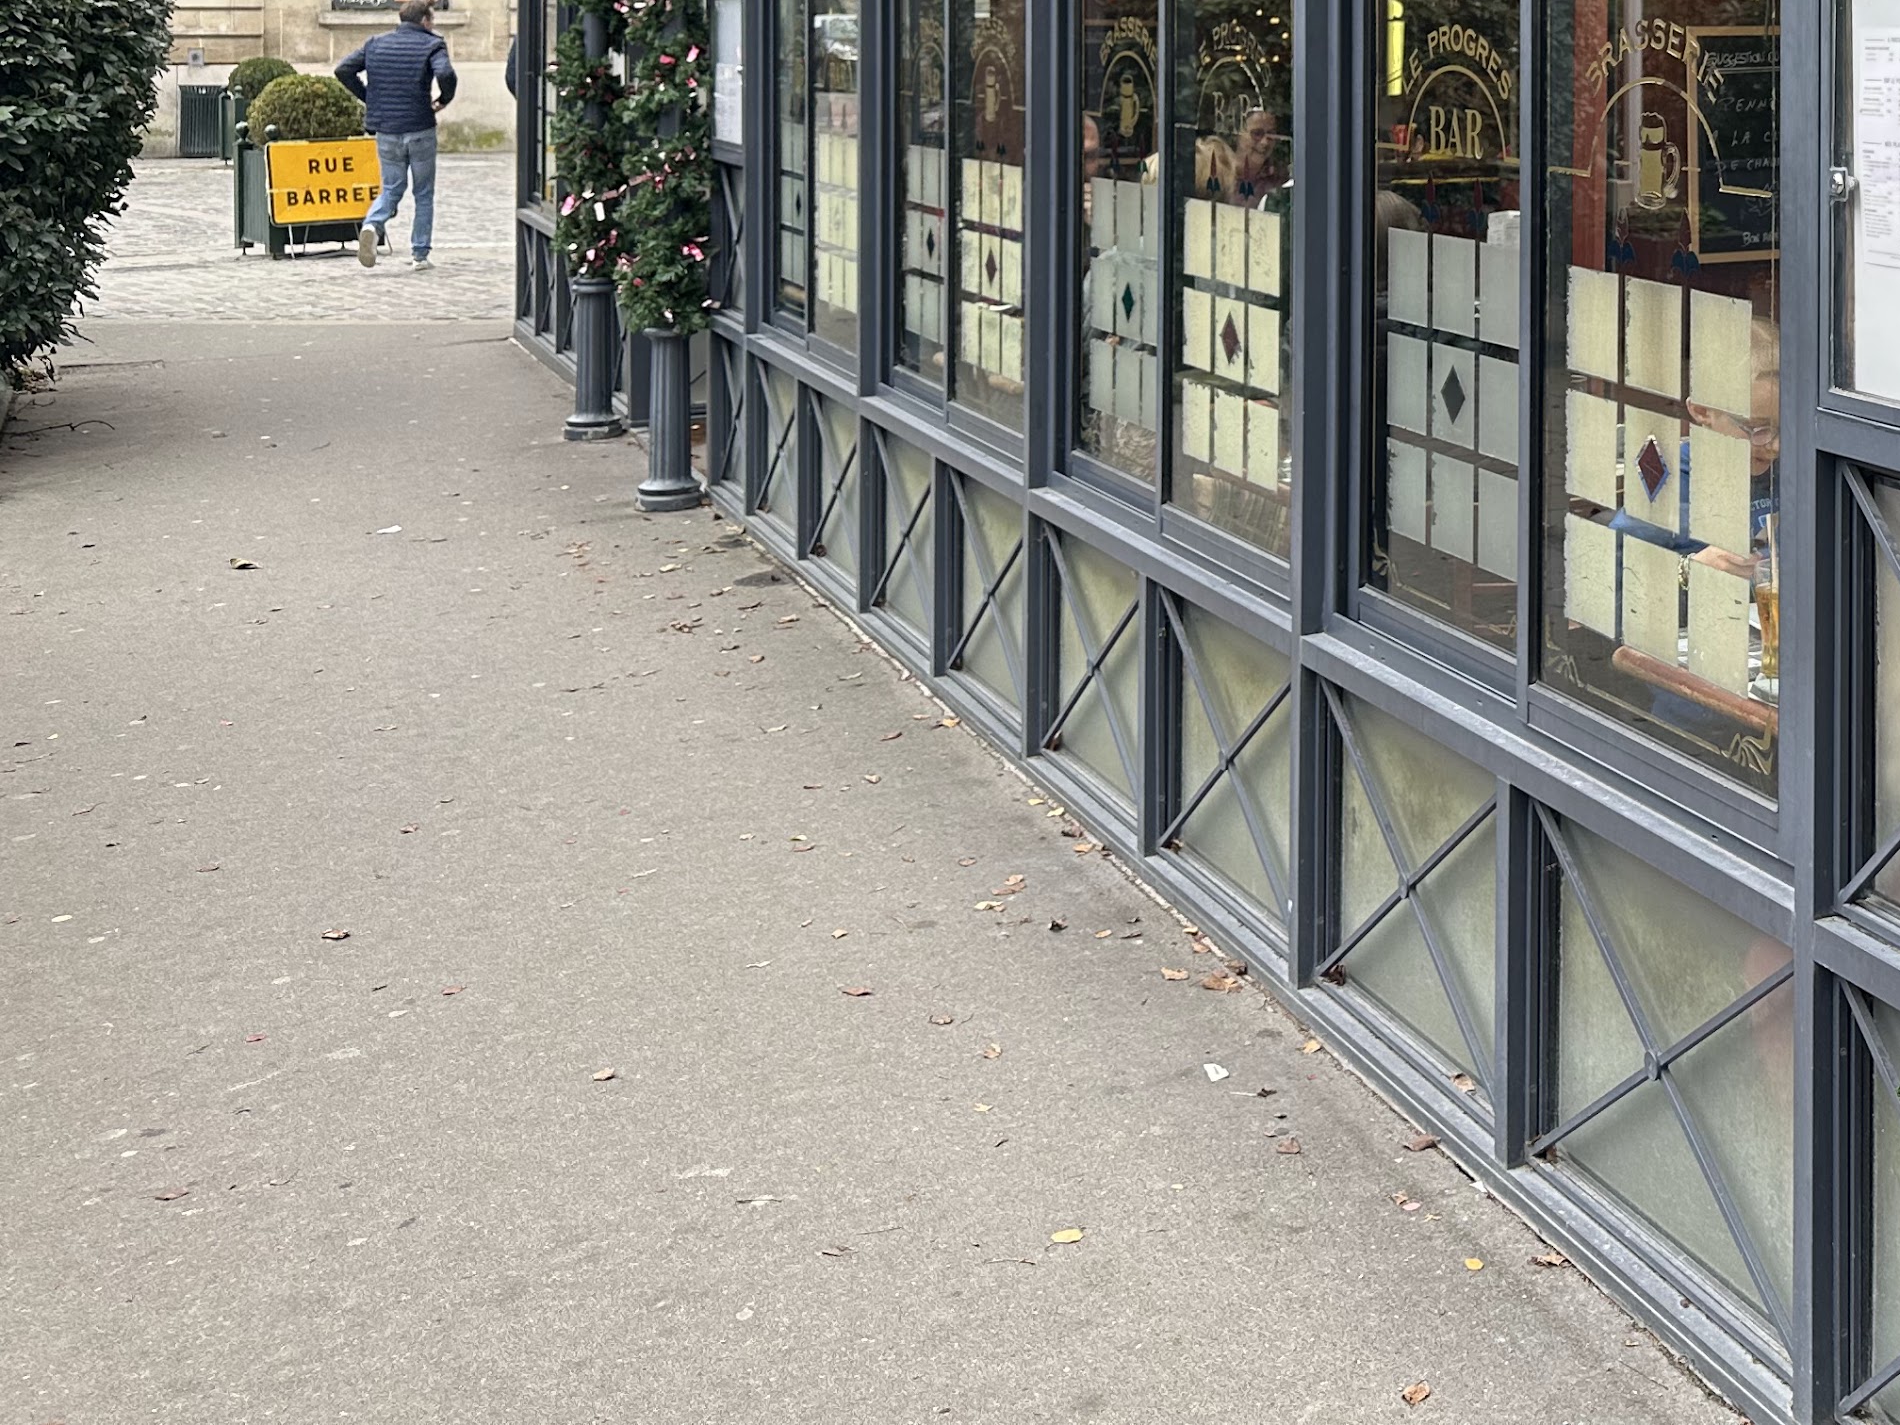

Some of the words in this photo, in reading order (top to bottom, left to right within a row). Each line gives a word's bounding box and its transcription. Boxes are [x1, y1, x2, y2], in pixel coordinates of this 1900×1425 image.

[1402, 48, 1423, 95] LE
[1427, 24, 1512, 100] PROGRES
[1429, 106, 1484, 160] BAR
[308, 156, 355, 174] RUE
[287, 185, 380, 206] BARREE
